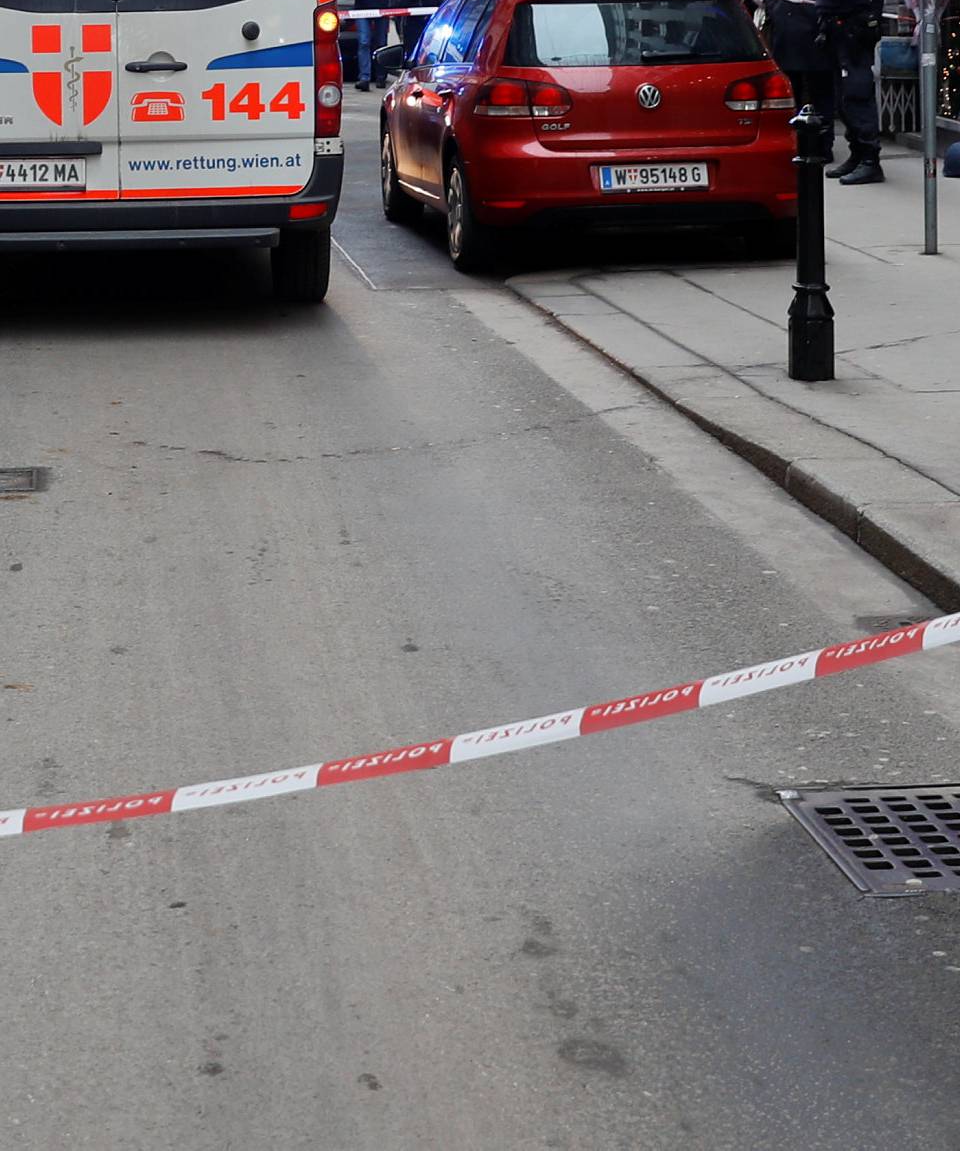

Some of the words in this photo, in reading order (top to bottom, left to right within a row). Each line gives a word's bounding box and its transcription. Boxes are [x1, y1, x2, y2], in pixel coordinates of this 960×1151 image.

[201, 81, 305, 121] 144
[541, 123, 571, 131] GOLF
[128, 153, 301, 172] www.rettung.wien.at
[5, 164, 49, 183] 4412
[54, 163, 80, 182] MA
[615, 169, 627, 185] W
[640, 167, 688, 184] 95148
[692, 166, 701, 183] G
